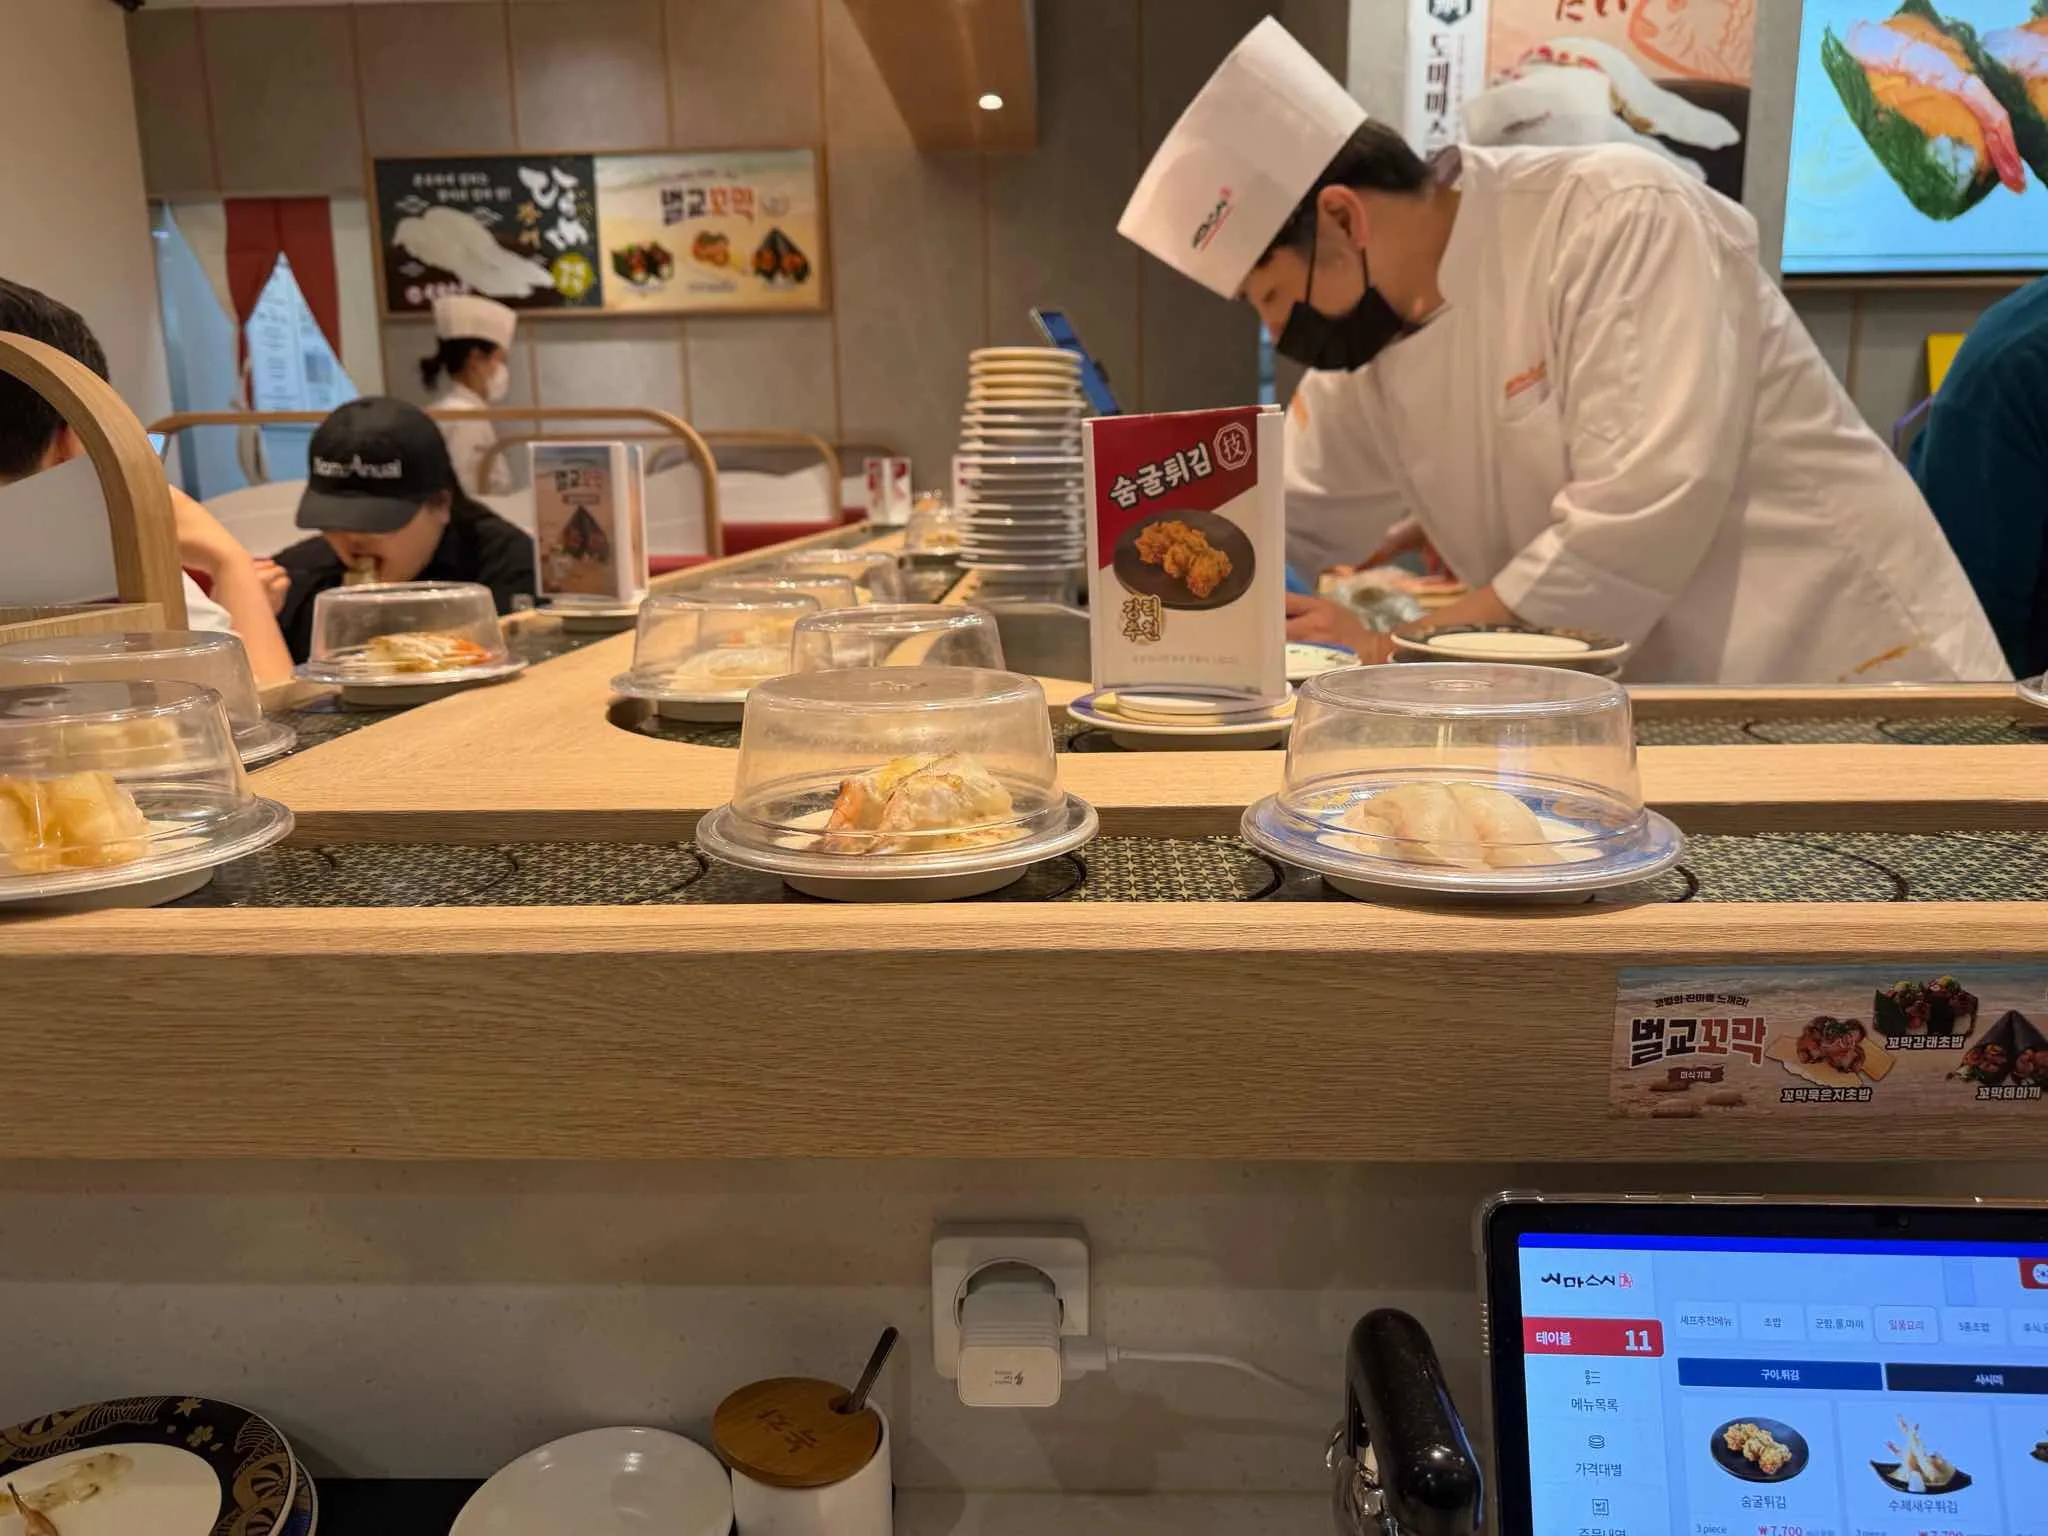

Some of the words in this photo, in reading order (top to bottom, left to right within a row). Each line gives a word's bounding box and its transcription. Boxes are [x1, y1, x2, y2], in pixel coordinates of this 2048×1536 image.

[661, 186, 754, 225] 벌교꼬막
[1631, 1016, 1766, 1068] 벌교꼬막
[1886, 1035, 1964, 1049] 꼬막감태초밥
[1782, 1088, 1871, 1102] 꼬막묵은지초밥
[1977, 1086, 2041, 1100] 꼬막데마끼
[1536, 1331, 1572, 1346] 테이블
[1625, 1329, 1652, 1351] 11
[1571, 1397, 1619, 1412] 메뉴목록
[1575, 1462, 1623, 1477] 가격대별
[1703, 1524, 1727, 1535] piece
